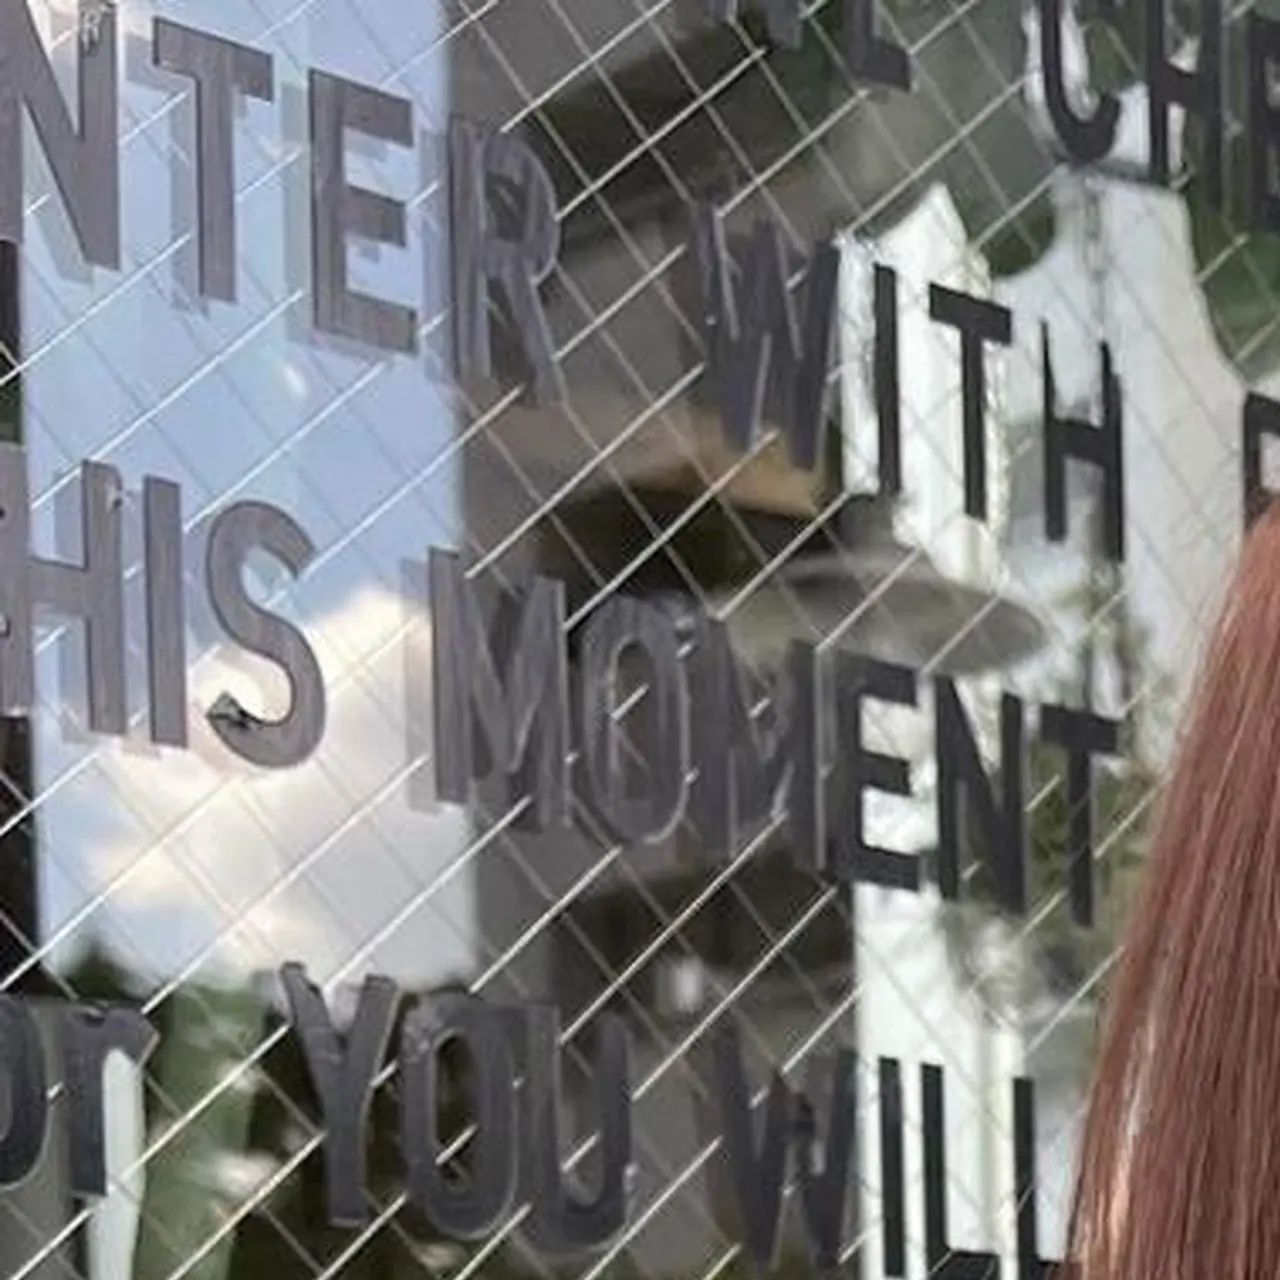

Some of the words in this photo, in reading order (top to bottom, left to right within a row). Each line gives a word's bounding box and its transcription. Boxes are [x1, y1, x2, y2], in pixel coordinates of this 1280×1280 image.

[692, 200, 1126, 562] WITH
[428, 546, 1118, 927] MOMENT
[280, 961, 632, 1258] YOU
